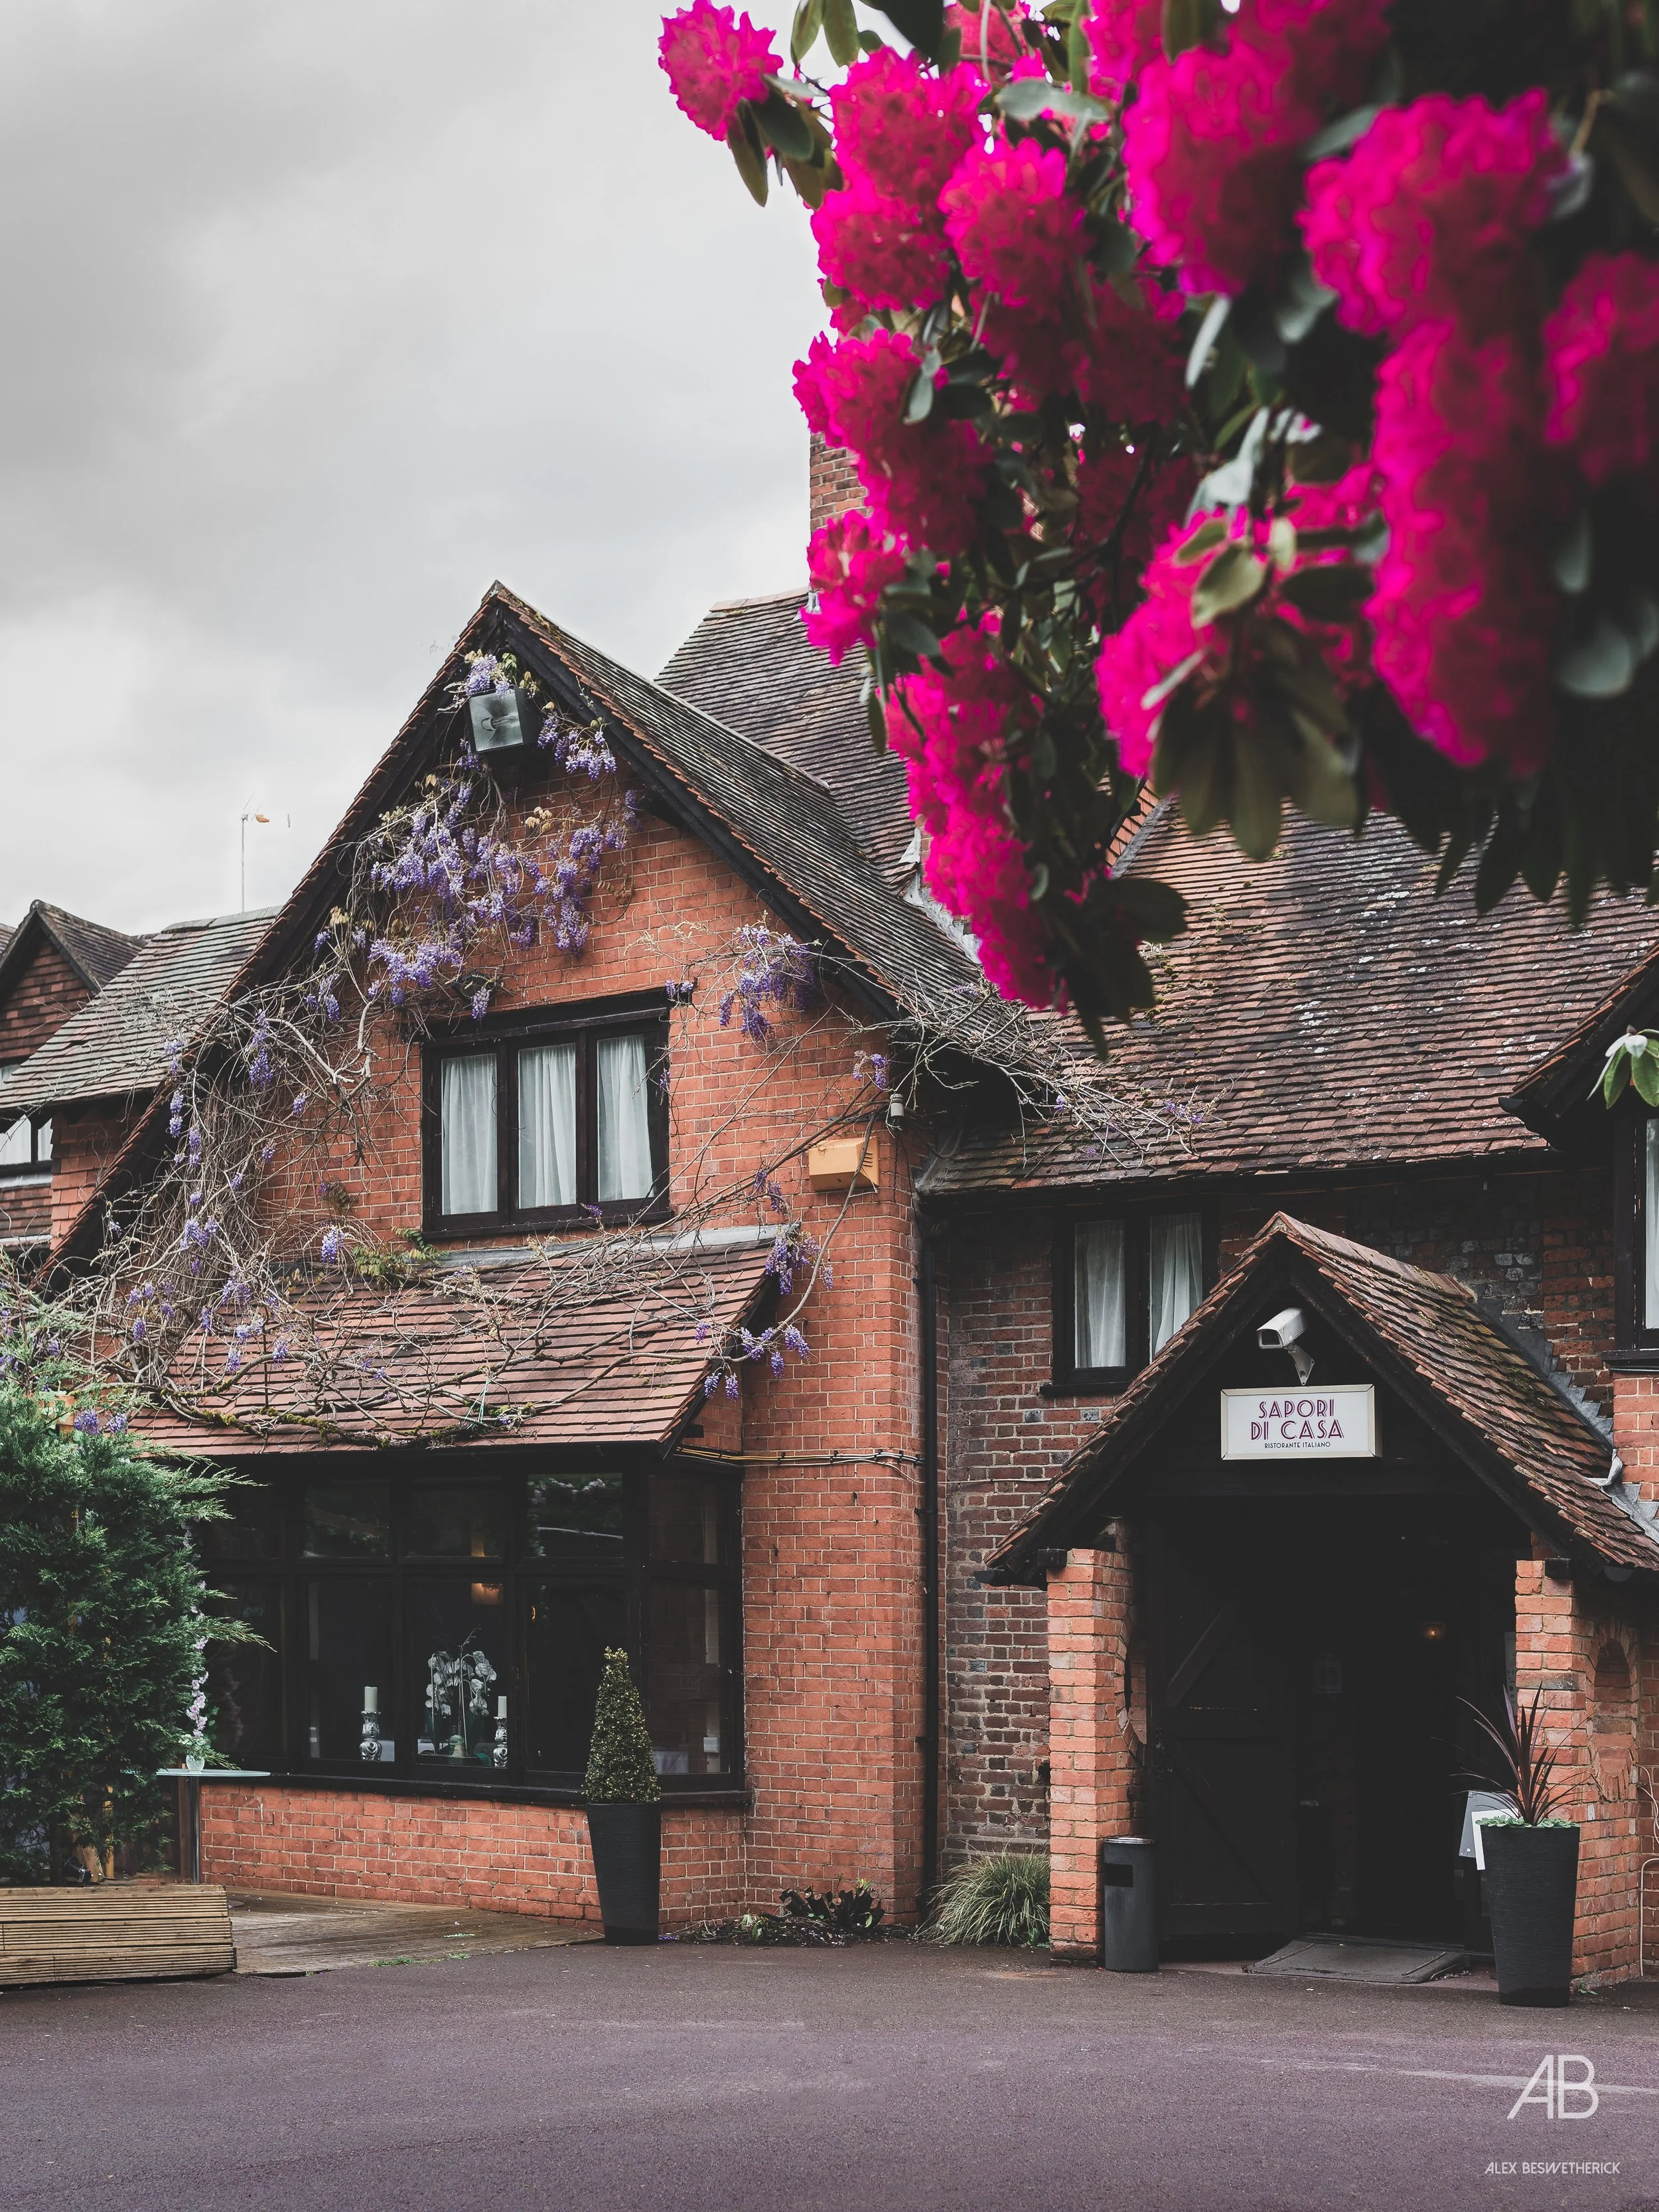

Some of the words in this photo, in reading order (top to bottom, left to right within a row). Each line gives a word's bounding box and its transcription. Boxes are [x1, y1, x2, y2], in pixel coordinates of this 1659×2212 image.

[1259, 1399, 1334, 1419] SAPORI
[1251, 1421, 1269, 1440] DI
[1281, 1419, 1345, 1440] CASA
